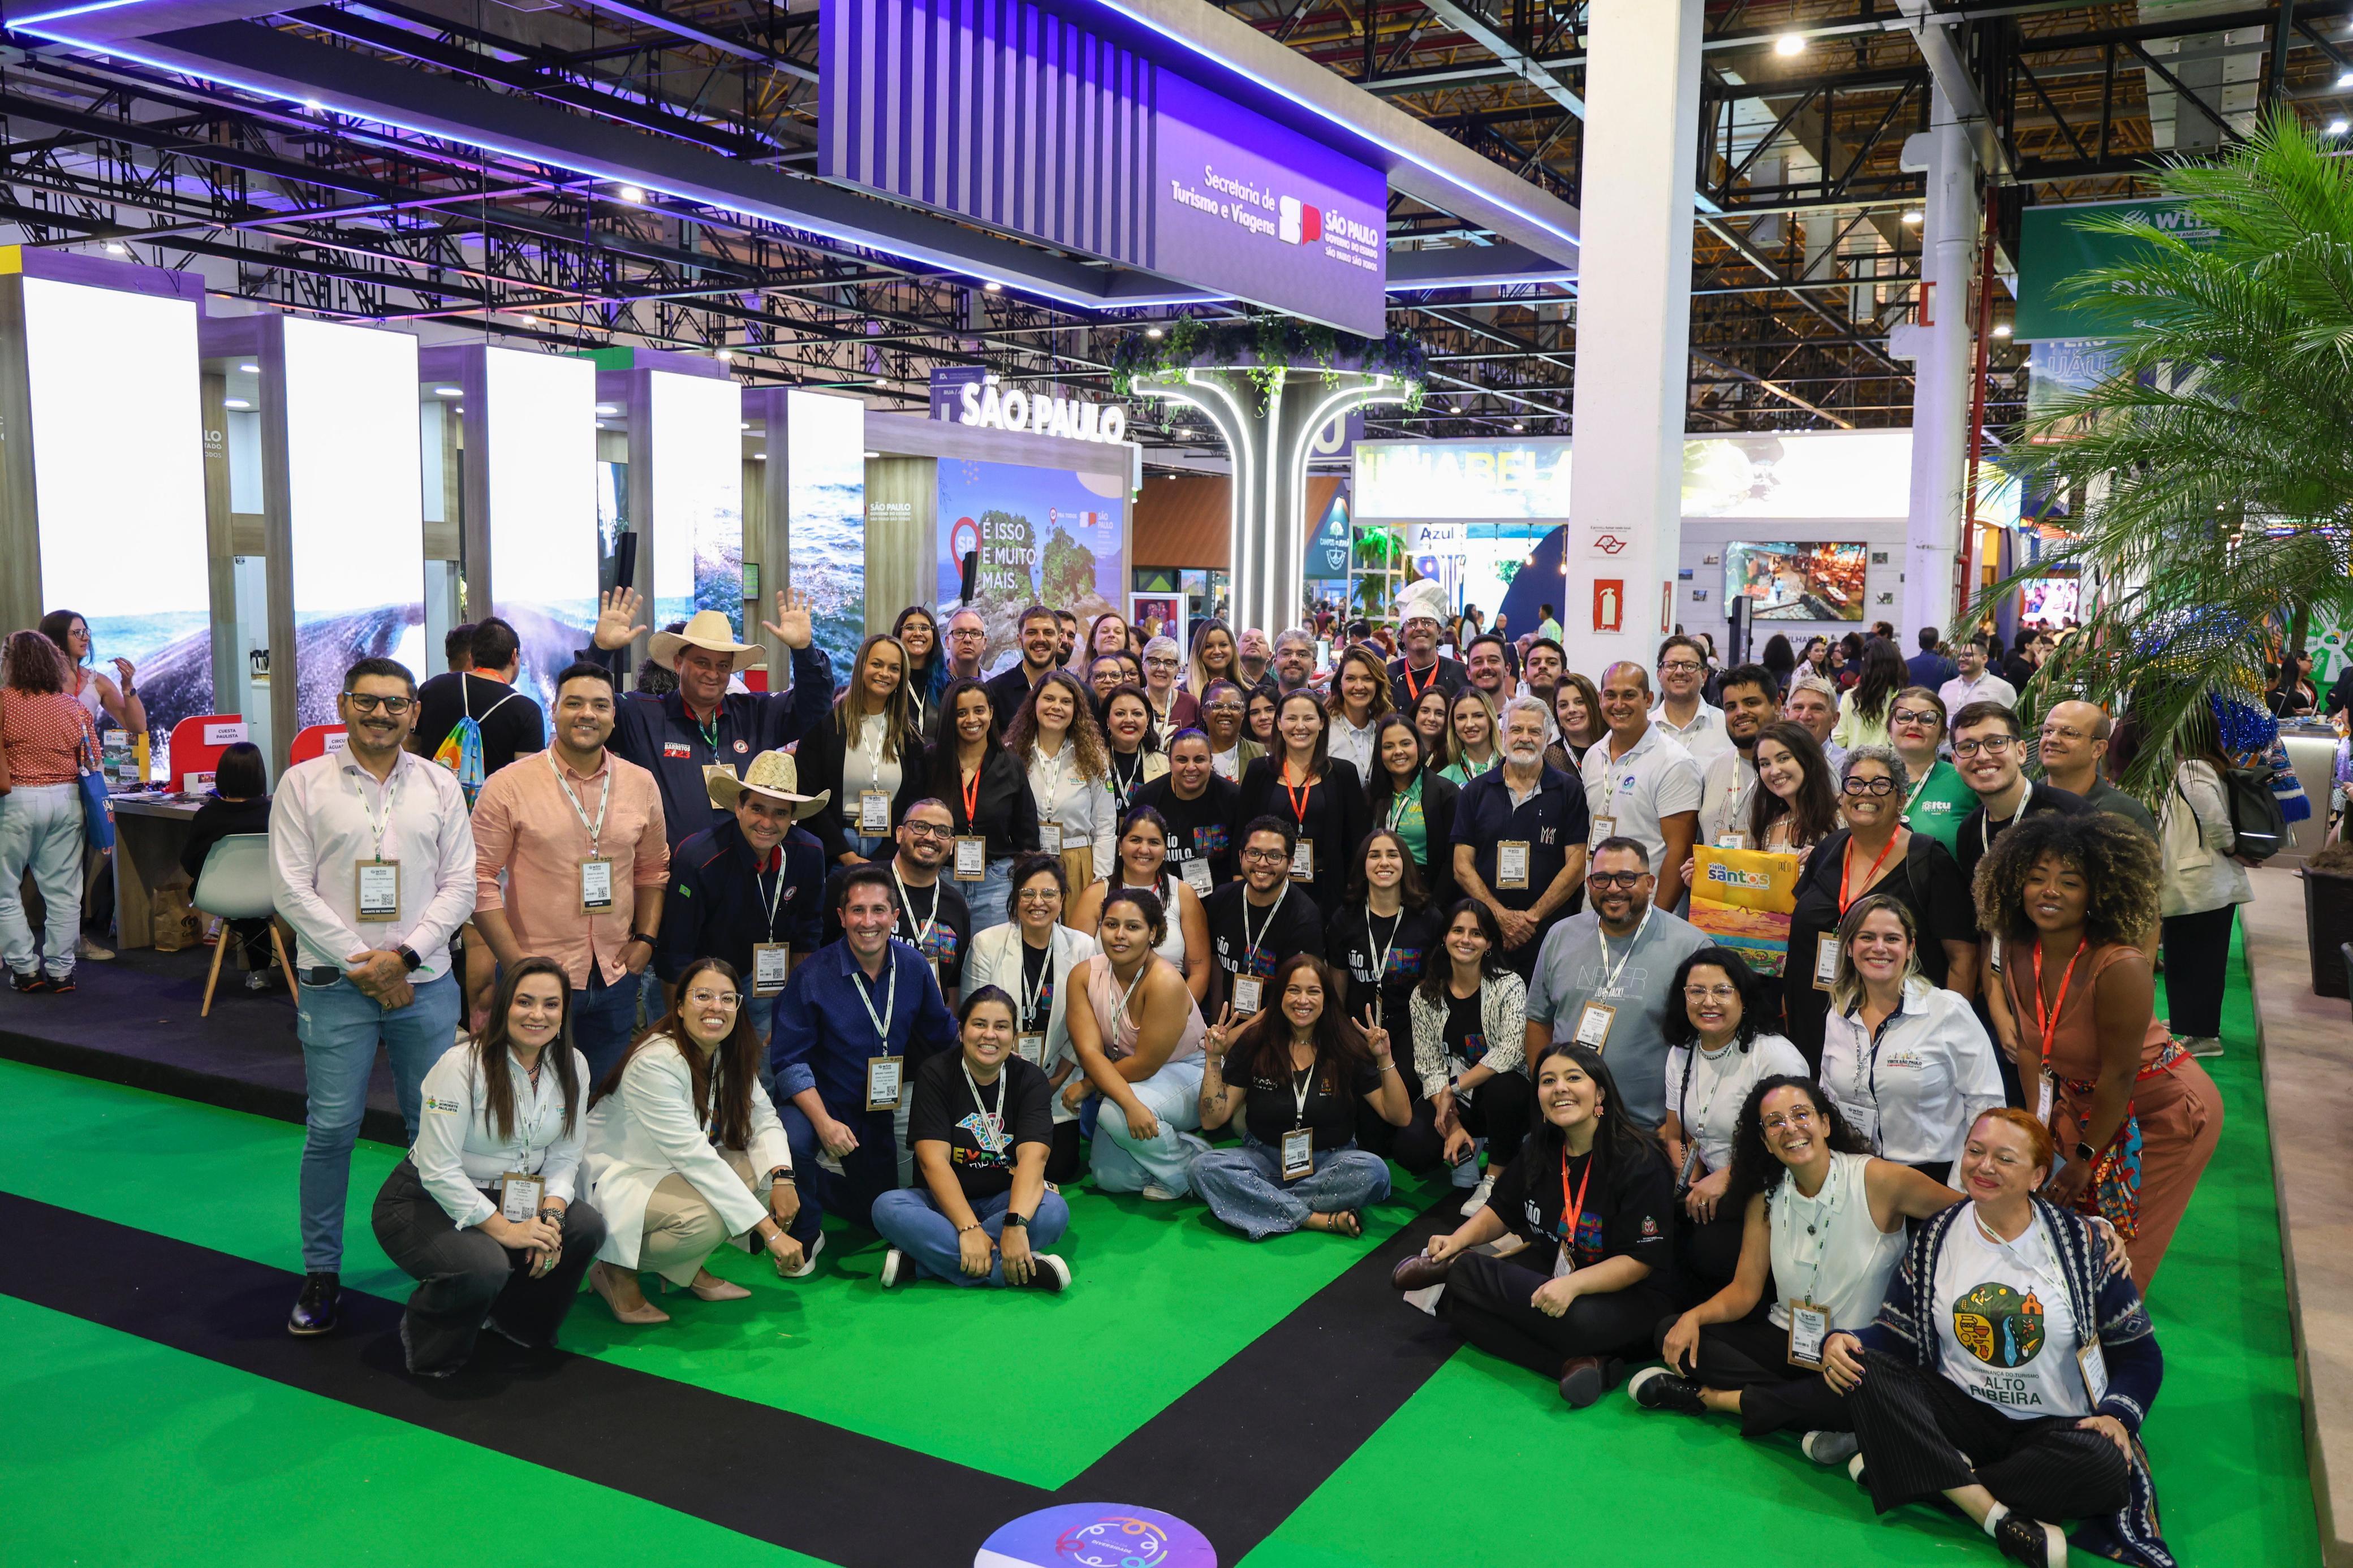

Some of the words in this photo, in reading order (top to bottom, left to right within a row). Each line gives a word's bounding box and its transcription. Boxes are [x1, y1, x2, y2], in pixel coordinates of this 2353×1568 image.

[1204, 165, 1260, 206] Secretaria
[1261, 188, 1275, 211] de
[1171, 180, 1218, 215] Turismo
[1220, 205, 1229, 219] e
[1230, 202, 1275, 236] Viagens
[1325, 209, 1347, 236] SÃO
[1347, 220, 1378, 248] PAULO
[1324, 232, 1351, 250] GOVERNO
[1351, 242, 1359, 253] DO
[1359, 245, 1378, 260] ESTADO
[1325, 245, 1336, 258] SÃO
[1336, 250, 1351, 263] PAULO
[1351, 255, 1362, 267] SÃO
[1362, 260, 1378, 272] TODOS
[959, 374, 1028, 432] SÃO
[1032, 394, 1126, 446] PAULO
[870, 502, 886, 511] SÃO
[886, 503, 911, 512] PAULO
[1097, 511, 1109, 521] SÃO
[982, 517, 991, 539] É
[996, 522, 1025, 541] ISSO
[1097, 520, 1114, 530] PAULO
[1420, 526, 1454, 541] Azul
[957, 535, 975, 552] SP
[982, 547, 991, 564] E
[996, 547, 1036, 565] MUITO
[982, 571, 1018, 589] MAIS.
[664, 744, 691, 752] BARRETOS
[1932, 801, 1951, 810] Itu
[1708, 869, 1770, 884] santos
[1348, 949, 1364, 968] SÃO
[1795, 1355, 1820, 1365] GOVERNAMENTAL
[1798, 1352, 1817, 1360] AUTORIDADE
[1971, 1366, 2005, 1377] GOVERNANÇA
[1984, 1376, 2025, 1391] ALTO
[1970, 1384, 2042, 1405] RIBEIRA
[1091, 1539, 1133, 1554] DIVERSIDADE
